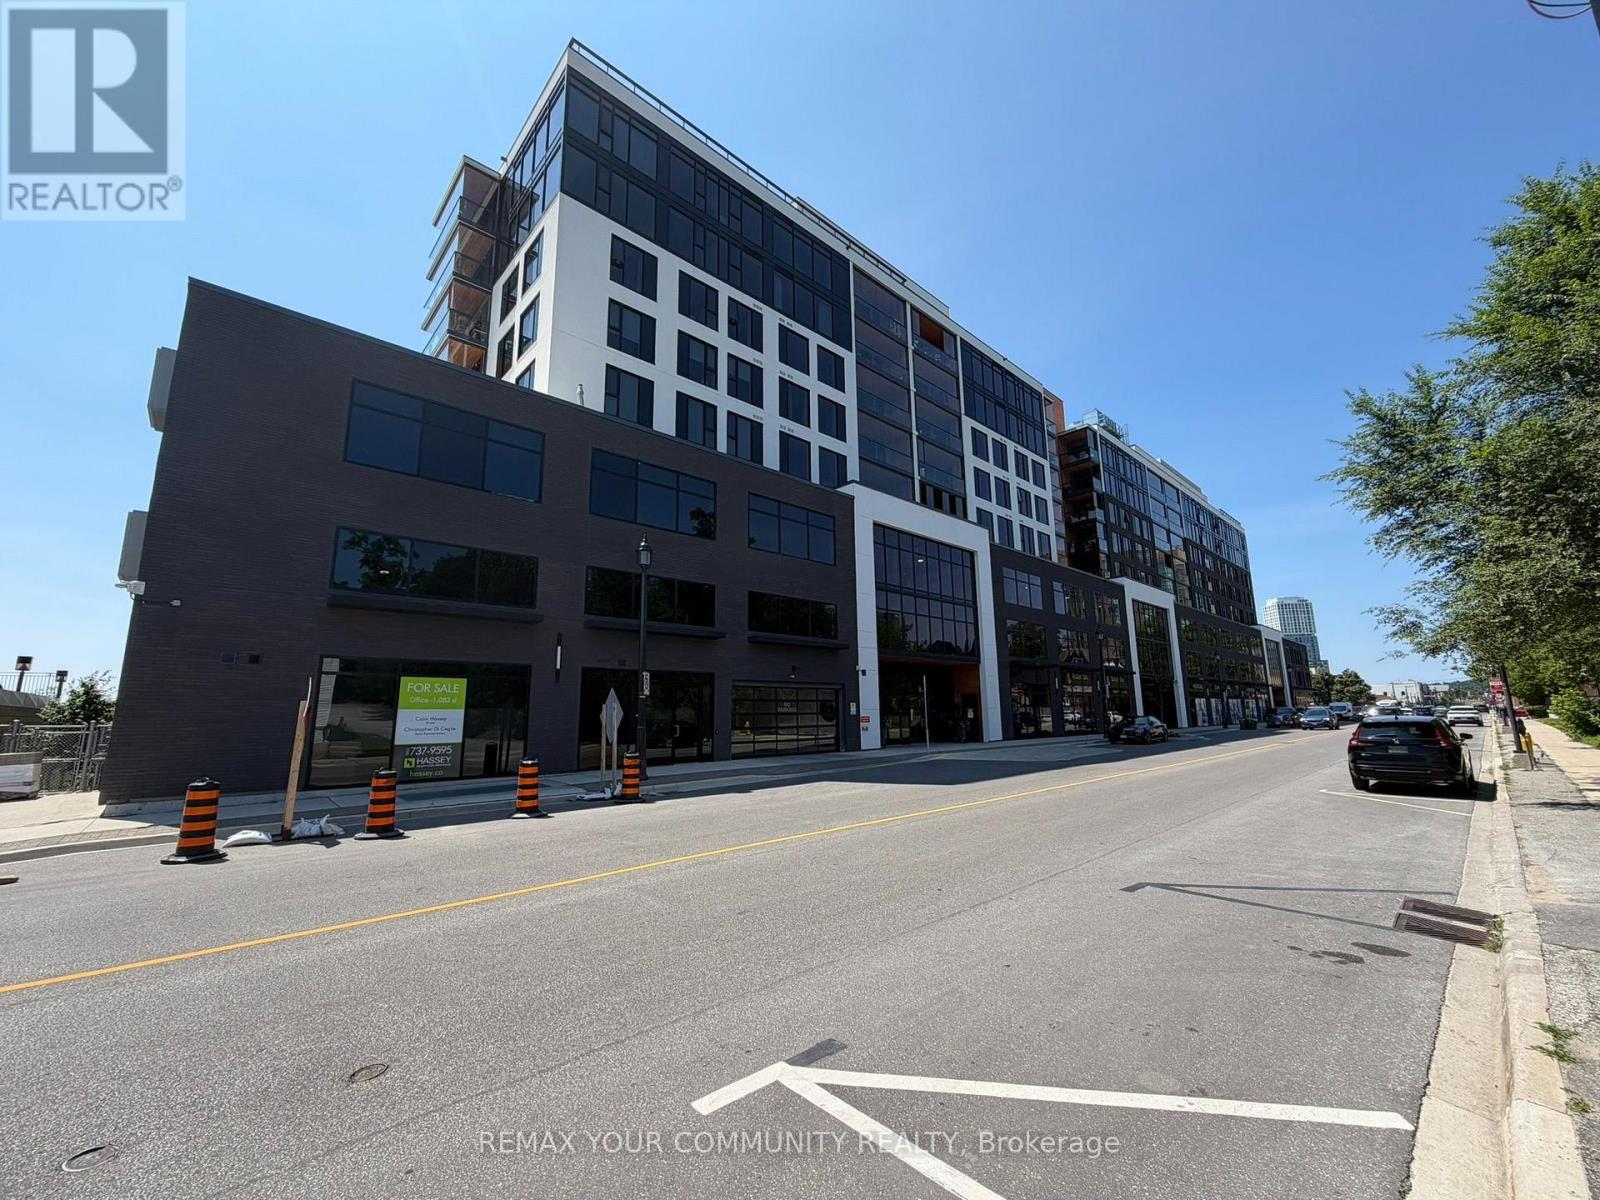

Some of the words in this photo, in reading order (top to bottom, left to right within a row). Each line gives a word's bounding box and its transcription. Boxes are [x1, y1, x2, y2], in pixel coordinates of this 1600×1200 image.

[407, 682, 431, 693] FOR
[434, 683, 460, 694] SALE
[409, 696, 429, 704] Office
[416, 756, 451, 764] HASSEY
